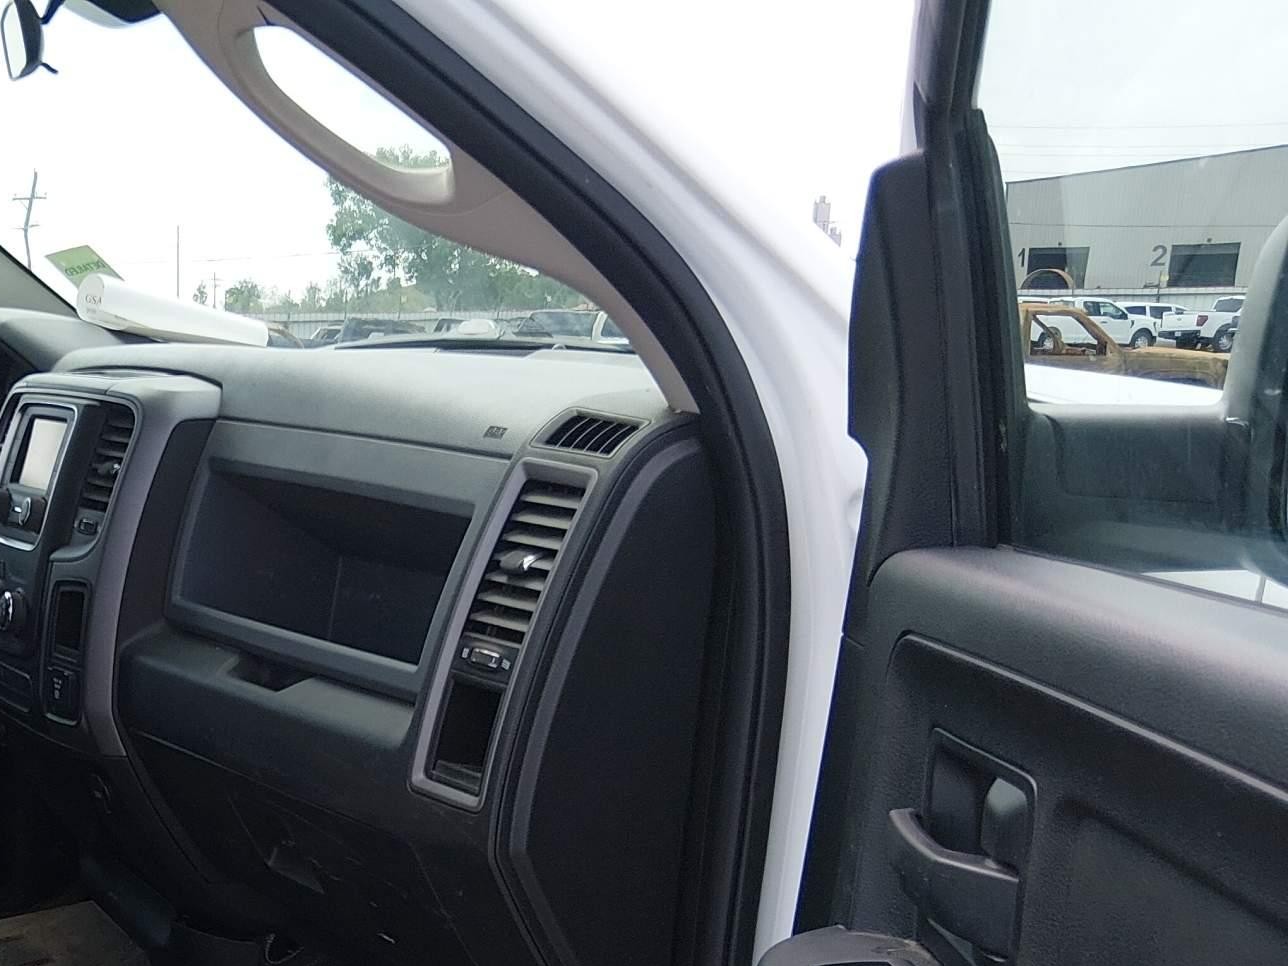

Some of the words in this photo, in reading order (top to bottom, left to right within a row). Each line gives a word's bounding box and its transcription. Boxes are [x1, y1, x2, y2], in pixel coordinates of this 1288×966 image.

[1017, 247, 1026, 268] 1
[1150, 244, 1168, 266] 2
[85, 294, 102, 305] GSA
